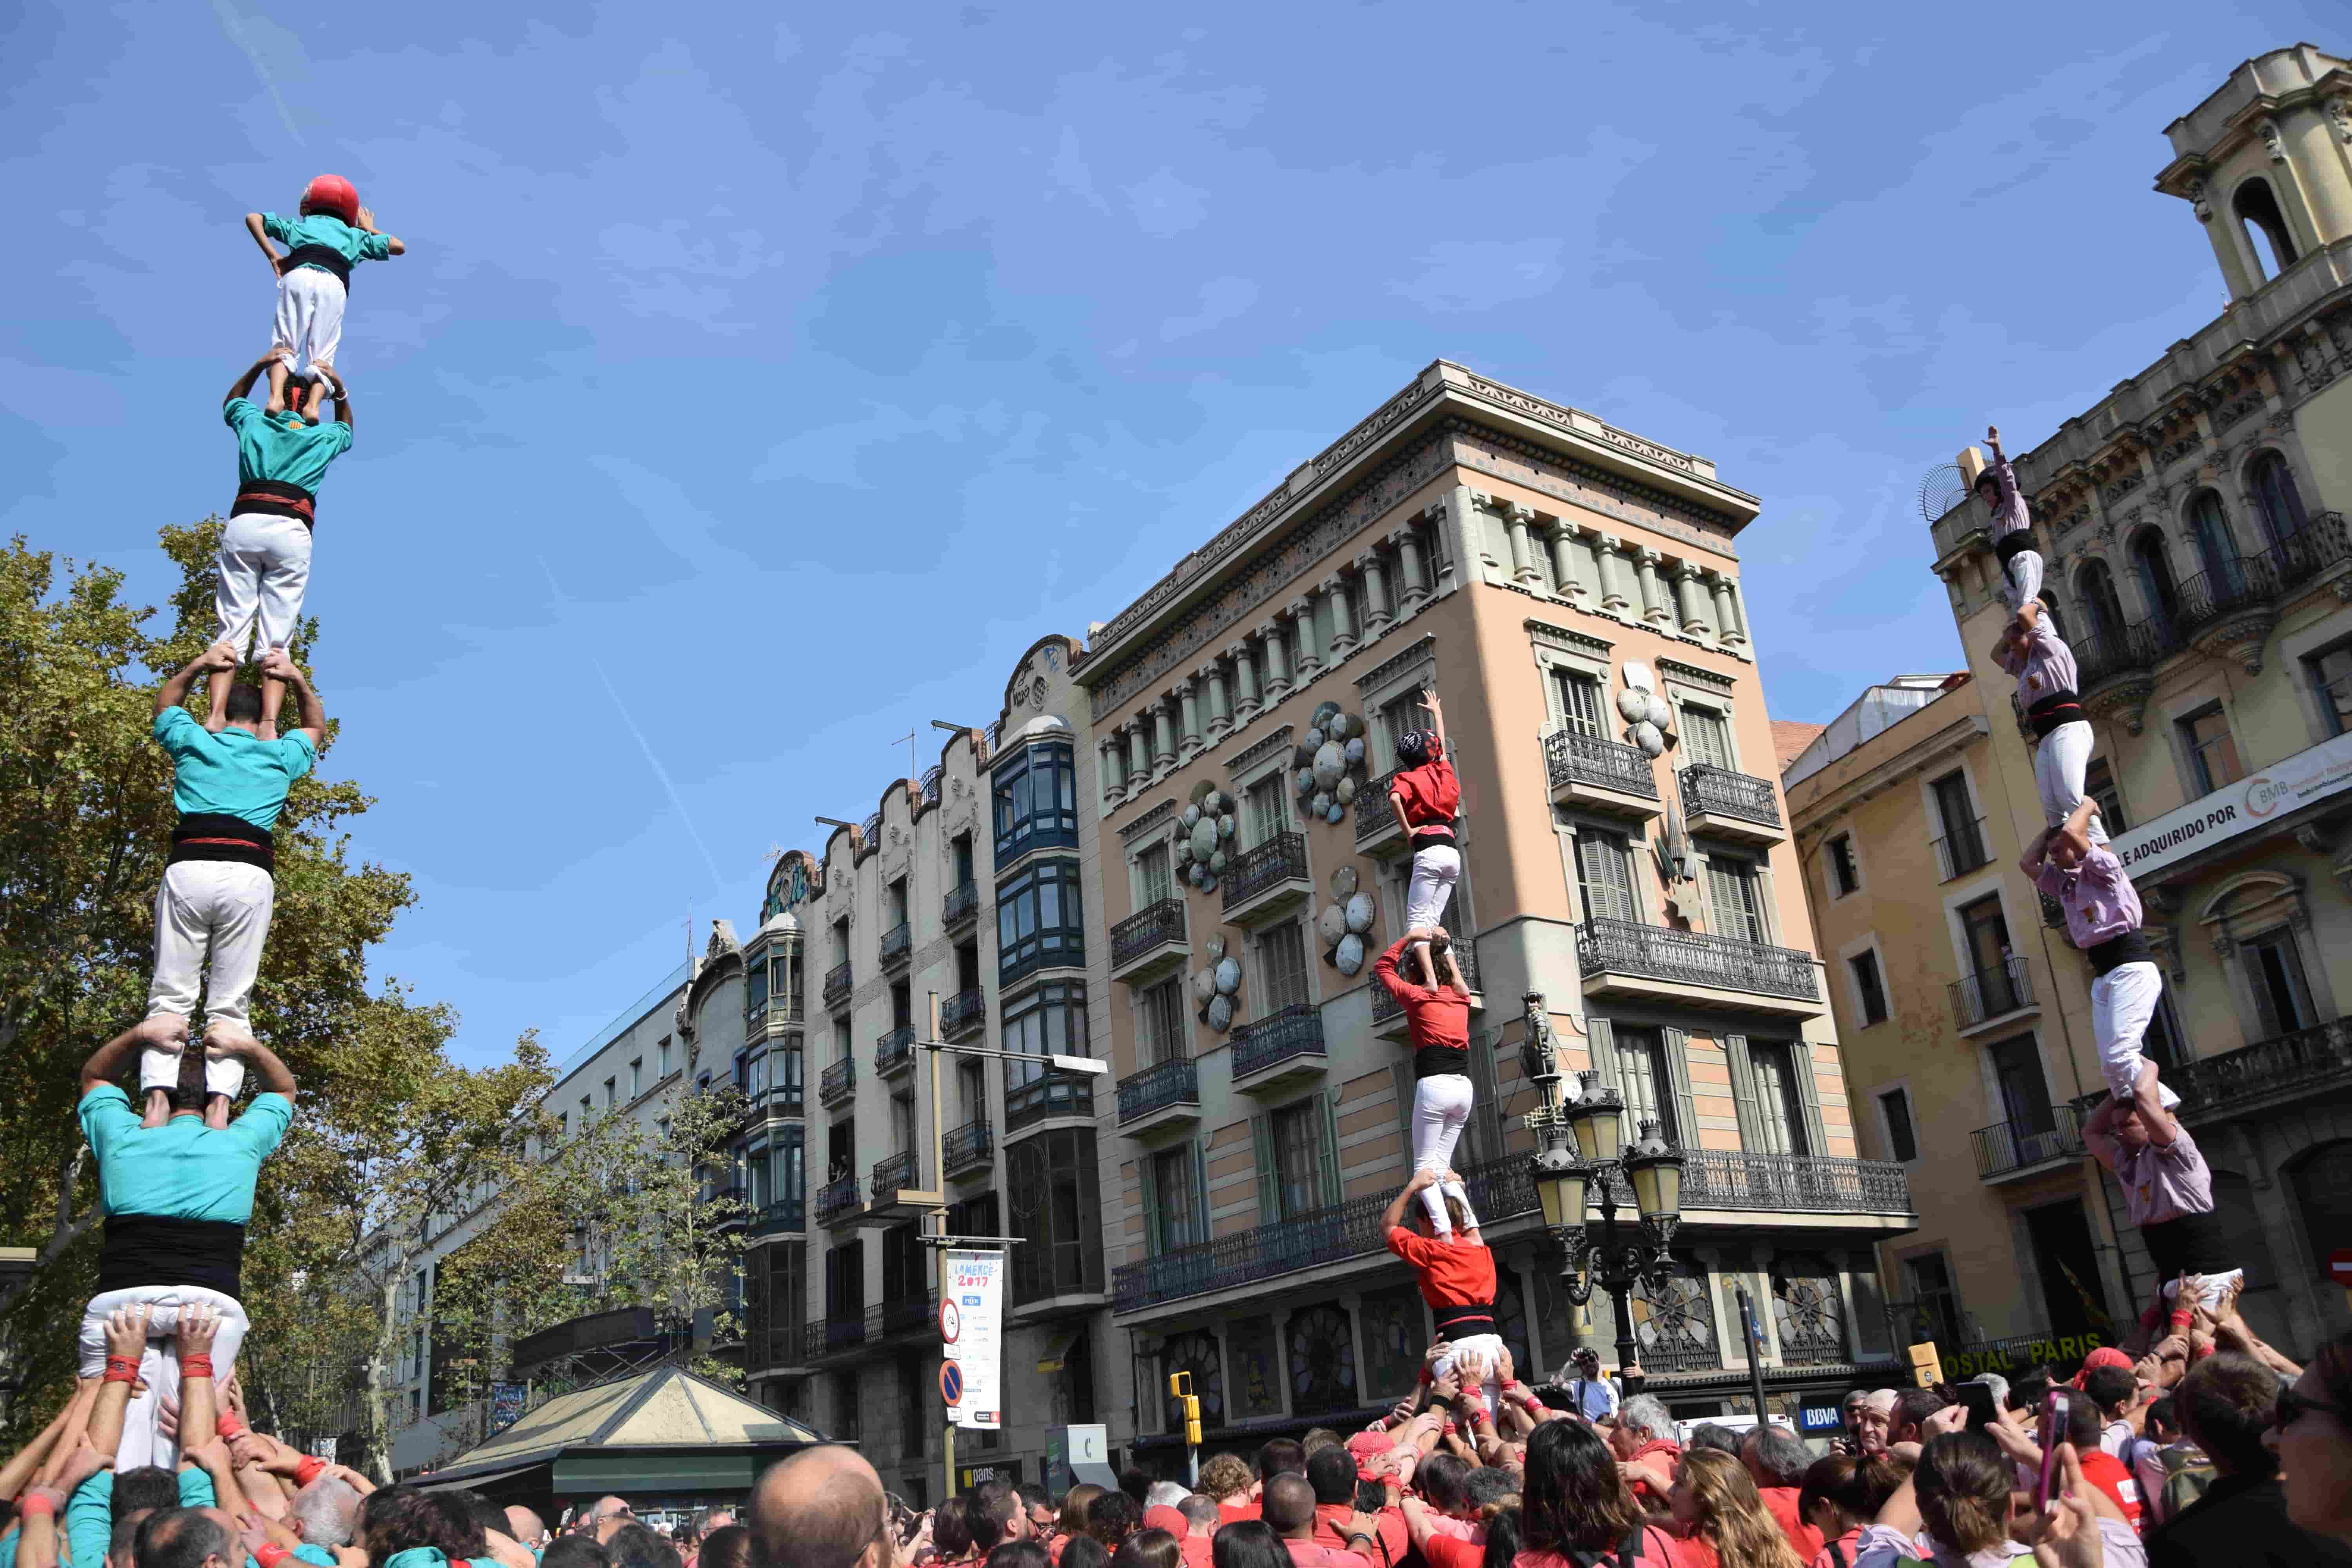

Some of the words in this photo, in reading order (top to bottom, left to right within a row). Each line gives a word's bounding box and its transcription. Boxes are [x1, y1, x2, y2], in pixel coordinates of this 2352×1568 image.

[2259, 781, 2288, 803] BMB
[2134, 819, 2205, 862] ADQUIRIDO
[2207, 805, 2236, 829] POR
[958, 1275, 988, 1286] 2017
[2029, 1332, 2102, 1364] PARIS
[1806, 1407, 1840, 1425] BBVA
[973, 1467, 994, 1486] pans
